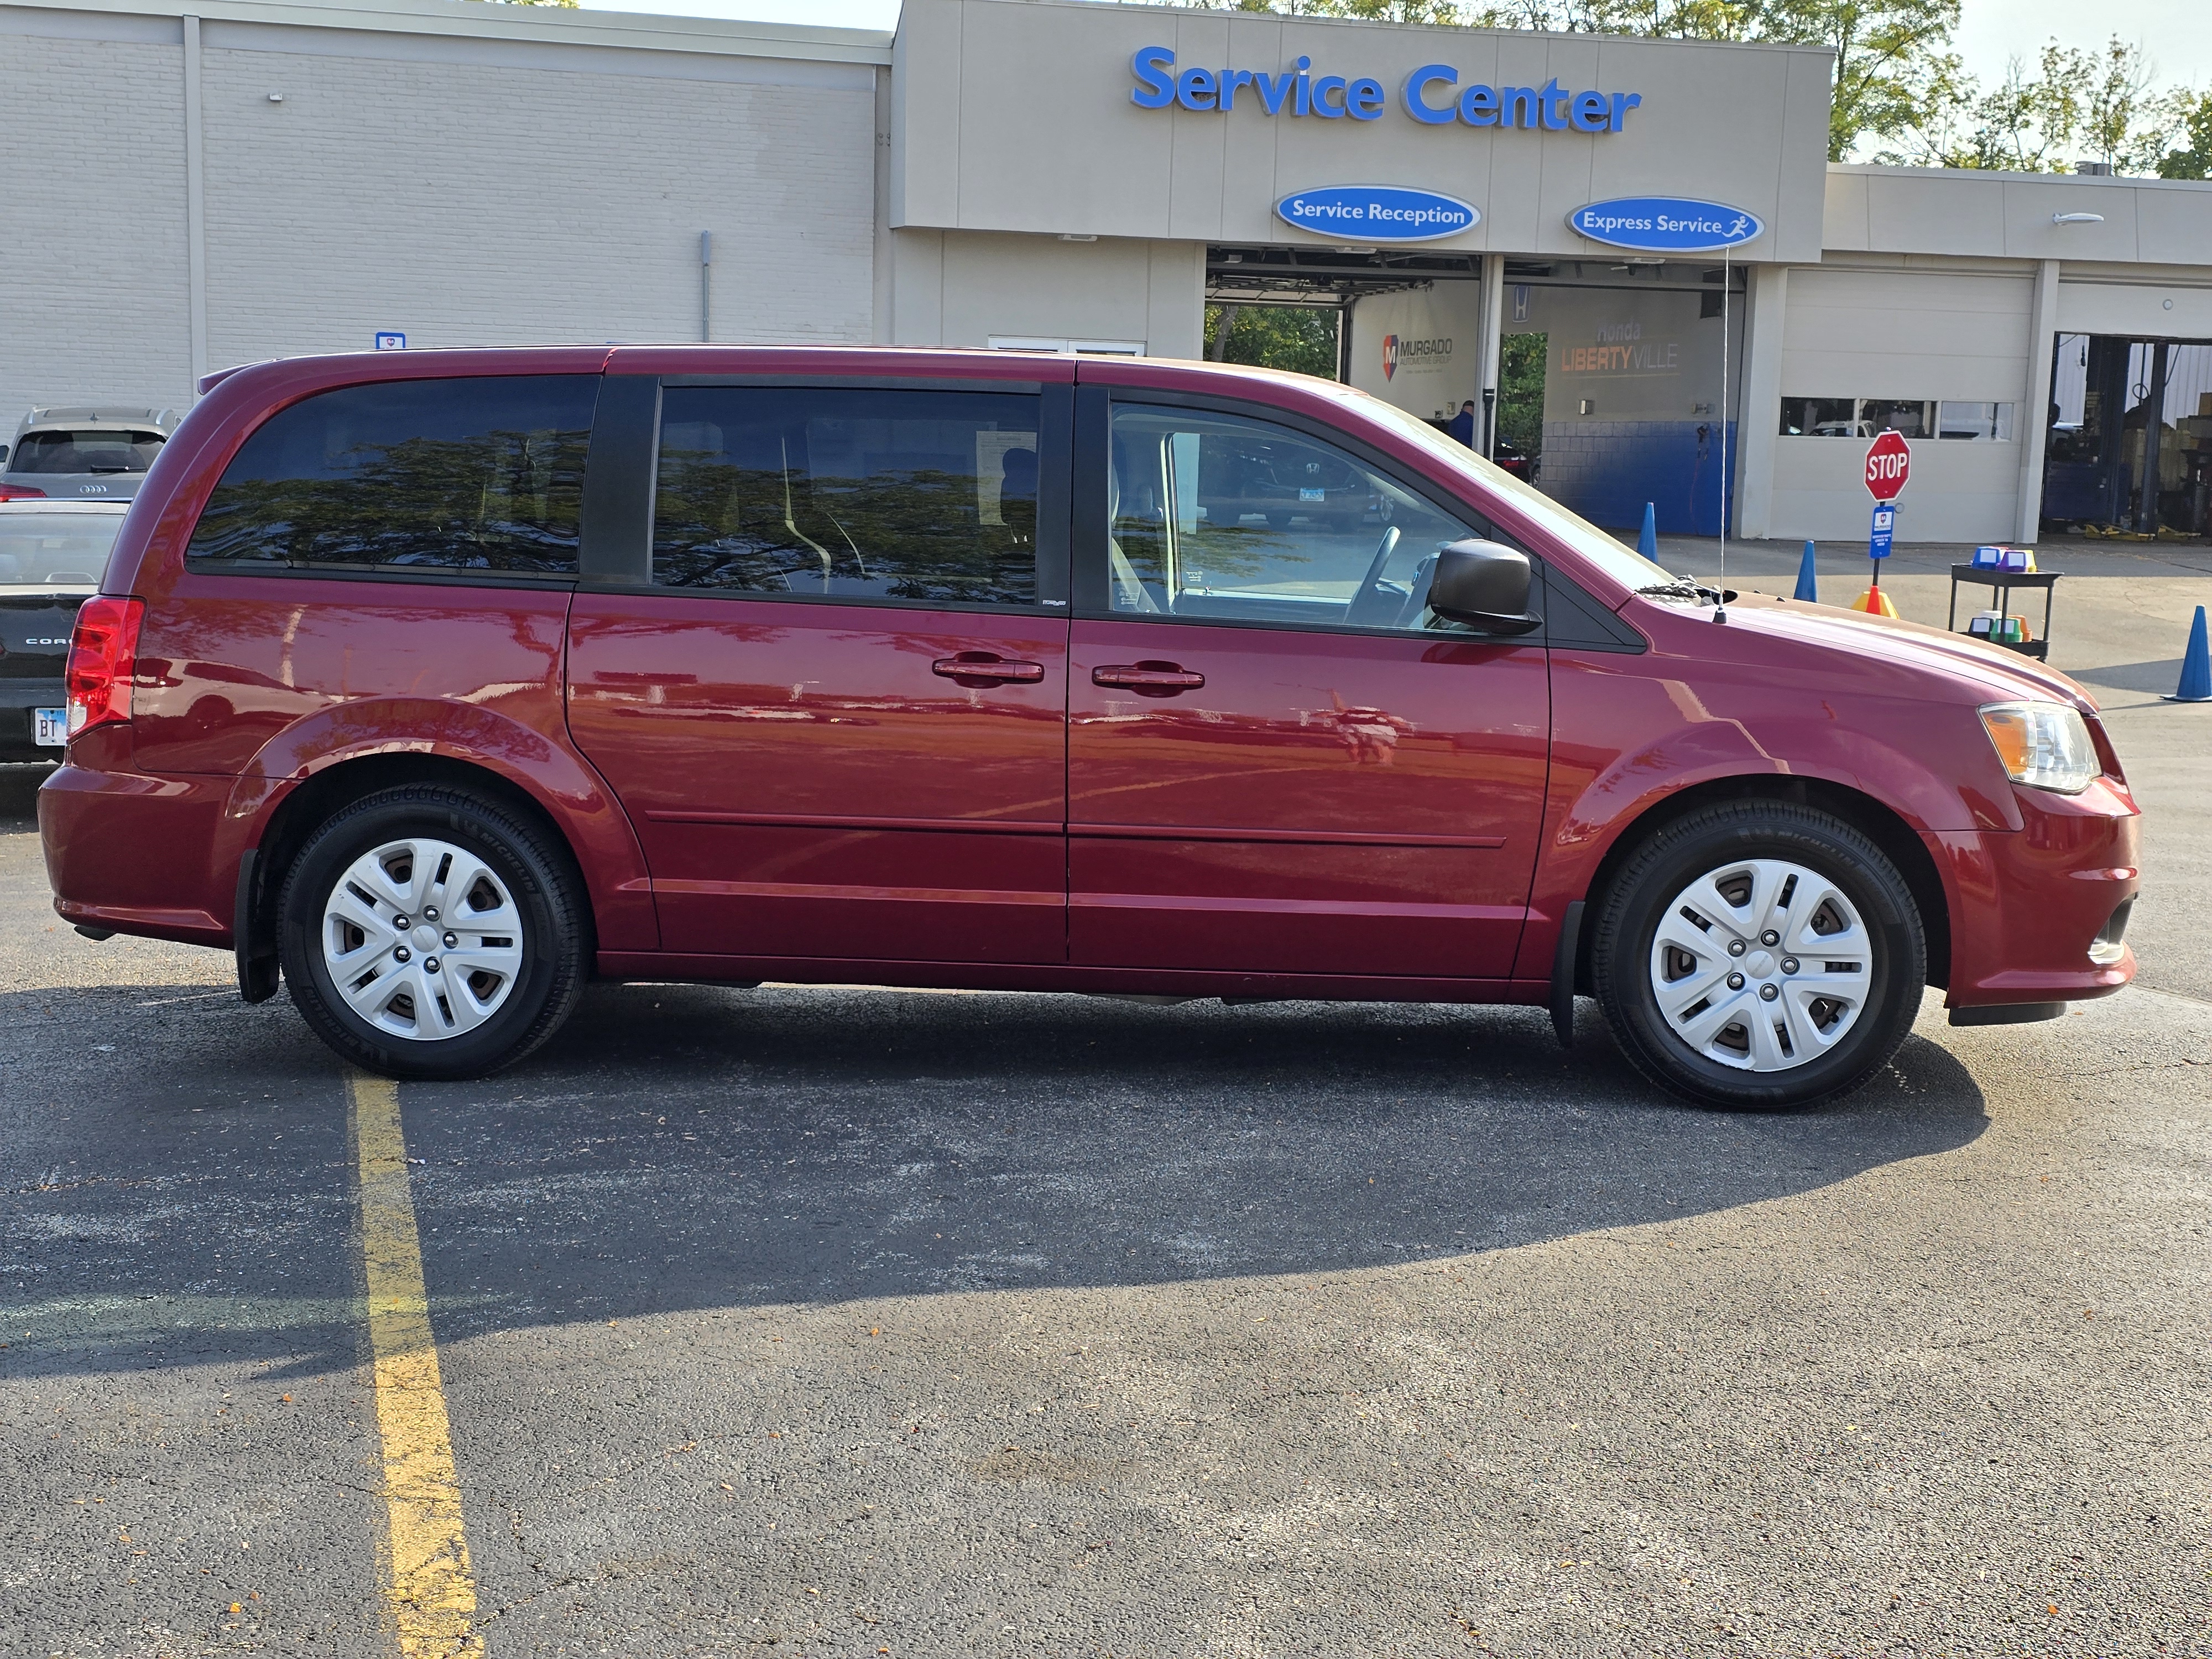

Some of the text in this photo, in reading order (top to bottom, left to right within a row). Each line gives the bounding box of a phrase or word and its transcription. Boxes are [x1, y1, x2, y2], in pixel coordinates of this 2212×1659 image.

[1131, 46, 1642, 132] Service Center
[1293, 199, 1465, 226] Service Reception
[1583, 212, 1722, 233] Express Service
[1597, 317, 1643, 342] Honda
[1400, 338, 1453, 357] MURGADO
[1400, 356, 1453, 366] AUTOMOTIVE GROUP
[1562, 343, 1679, 372] LIBERTYVILLE
[1867, 452, 1907, 481] STOP
[479, 832, 536, 891] MICHELIN
